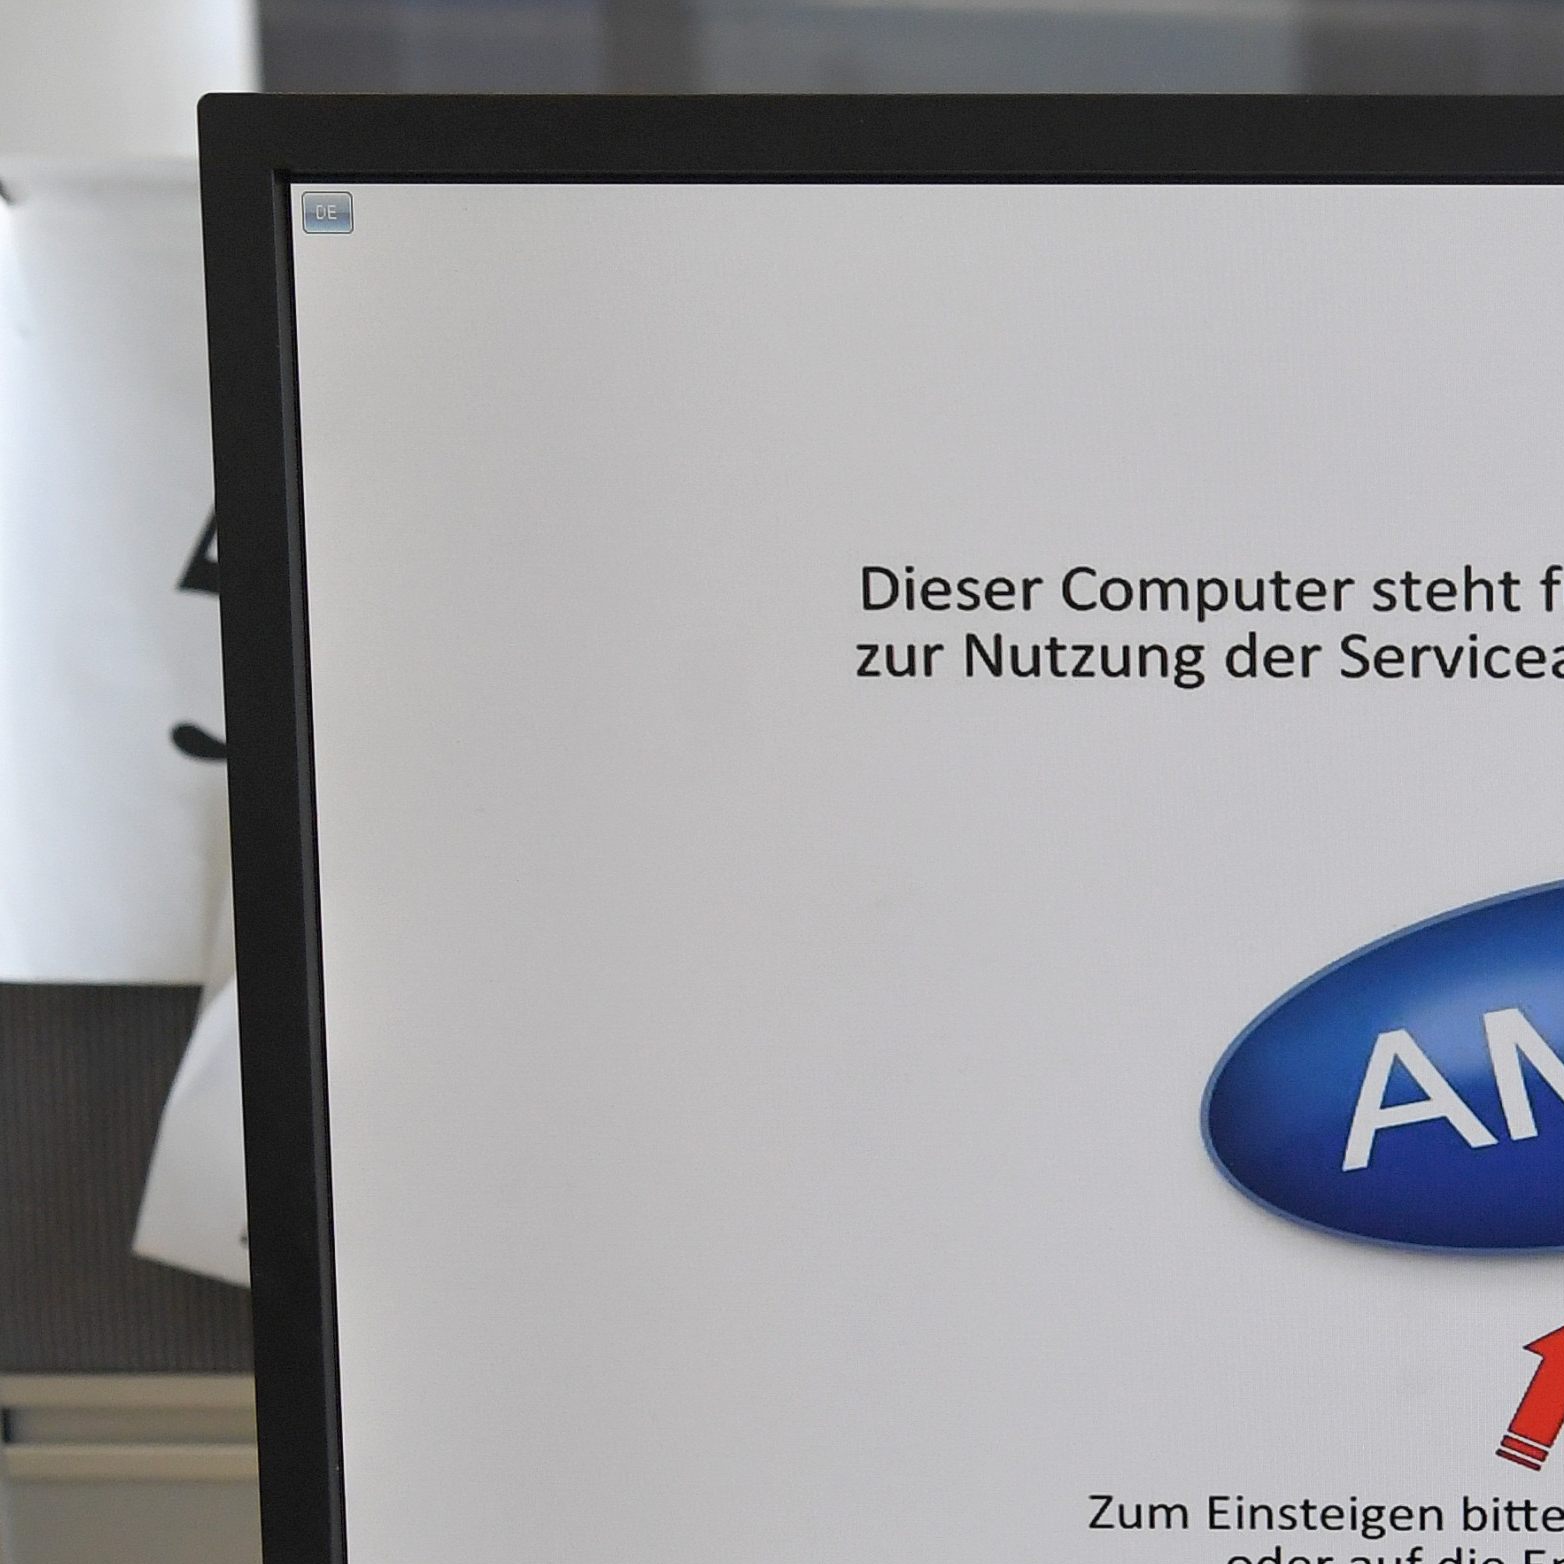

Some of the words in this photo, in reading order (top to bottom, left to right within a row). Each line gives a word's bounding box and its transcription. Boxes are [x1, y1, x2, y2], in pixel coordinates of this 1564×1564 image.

[315, 205, 337, 220] DE
[862, 566, 1043, 612] Dieser
[1062, 567, 1355, 623] Computer
[1373, 565, 1520, 612] steht
[856, 644, 944, 678] zur
[966, 633, 1205, 689] Nutzung
[1226, 631, 1322, 678] der
[1089, 1496, 1188, 1530] Zum
[1209, 1495, 1443, 1540] Einsteigen
